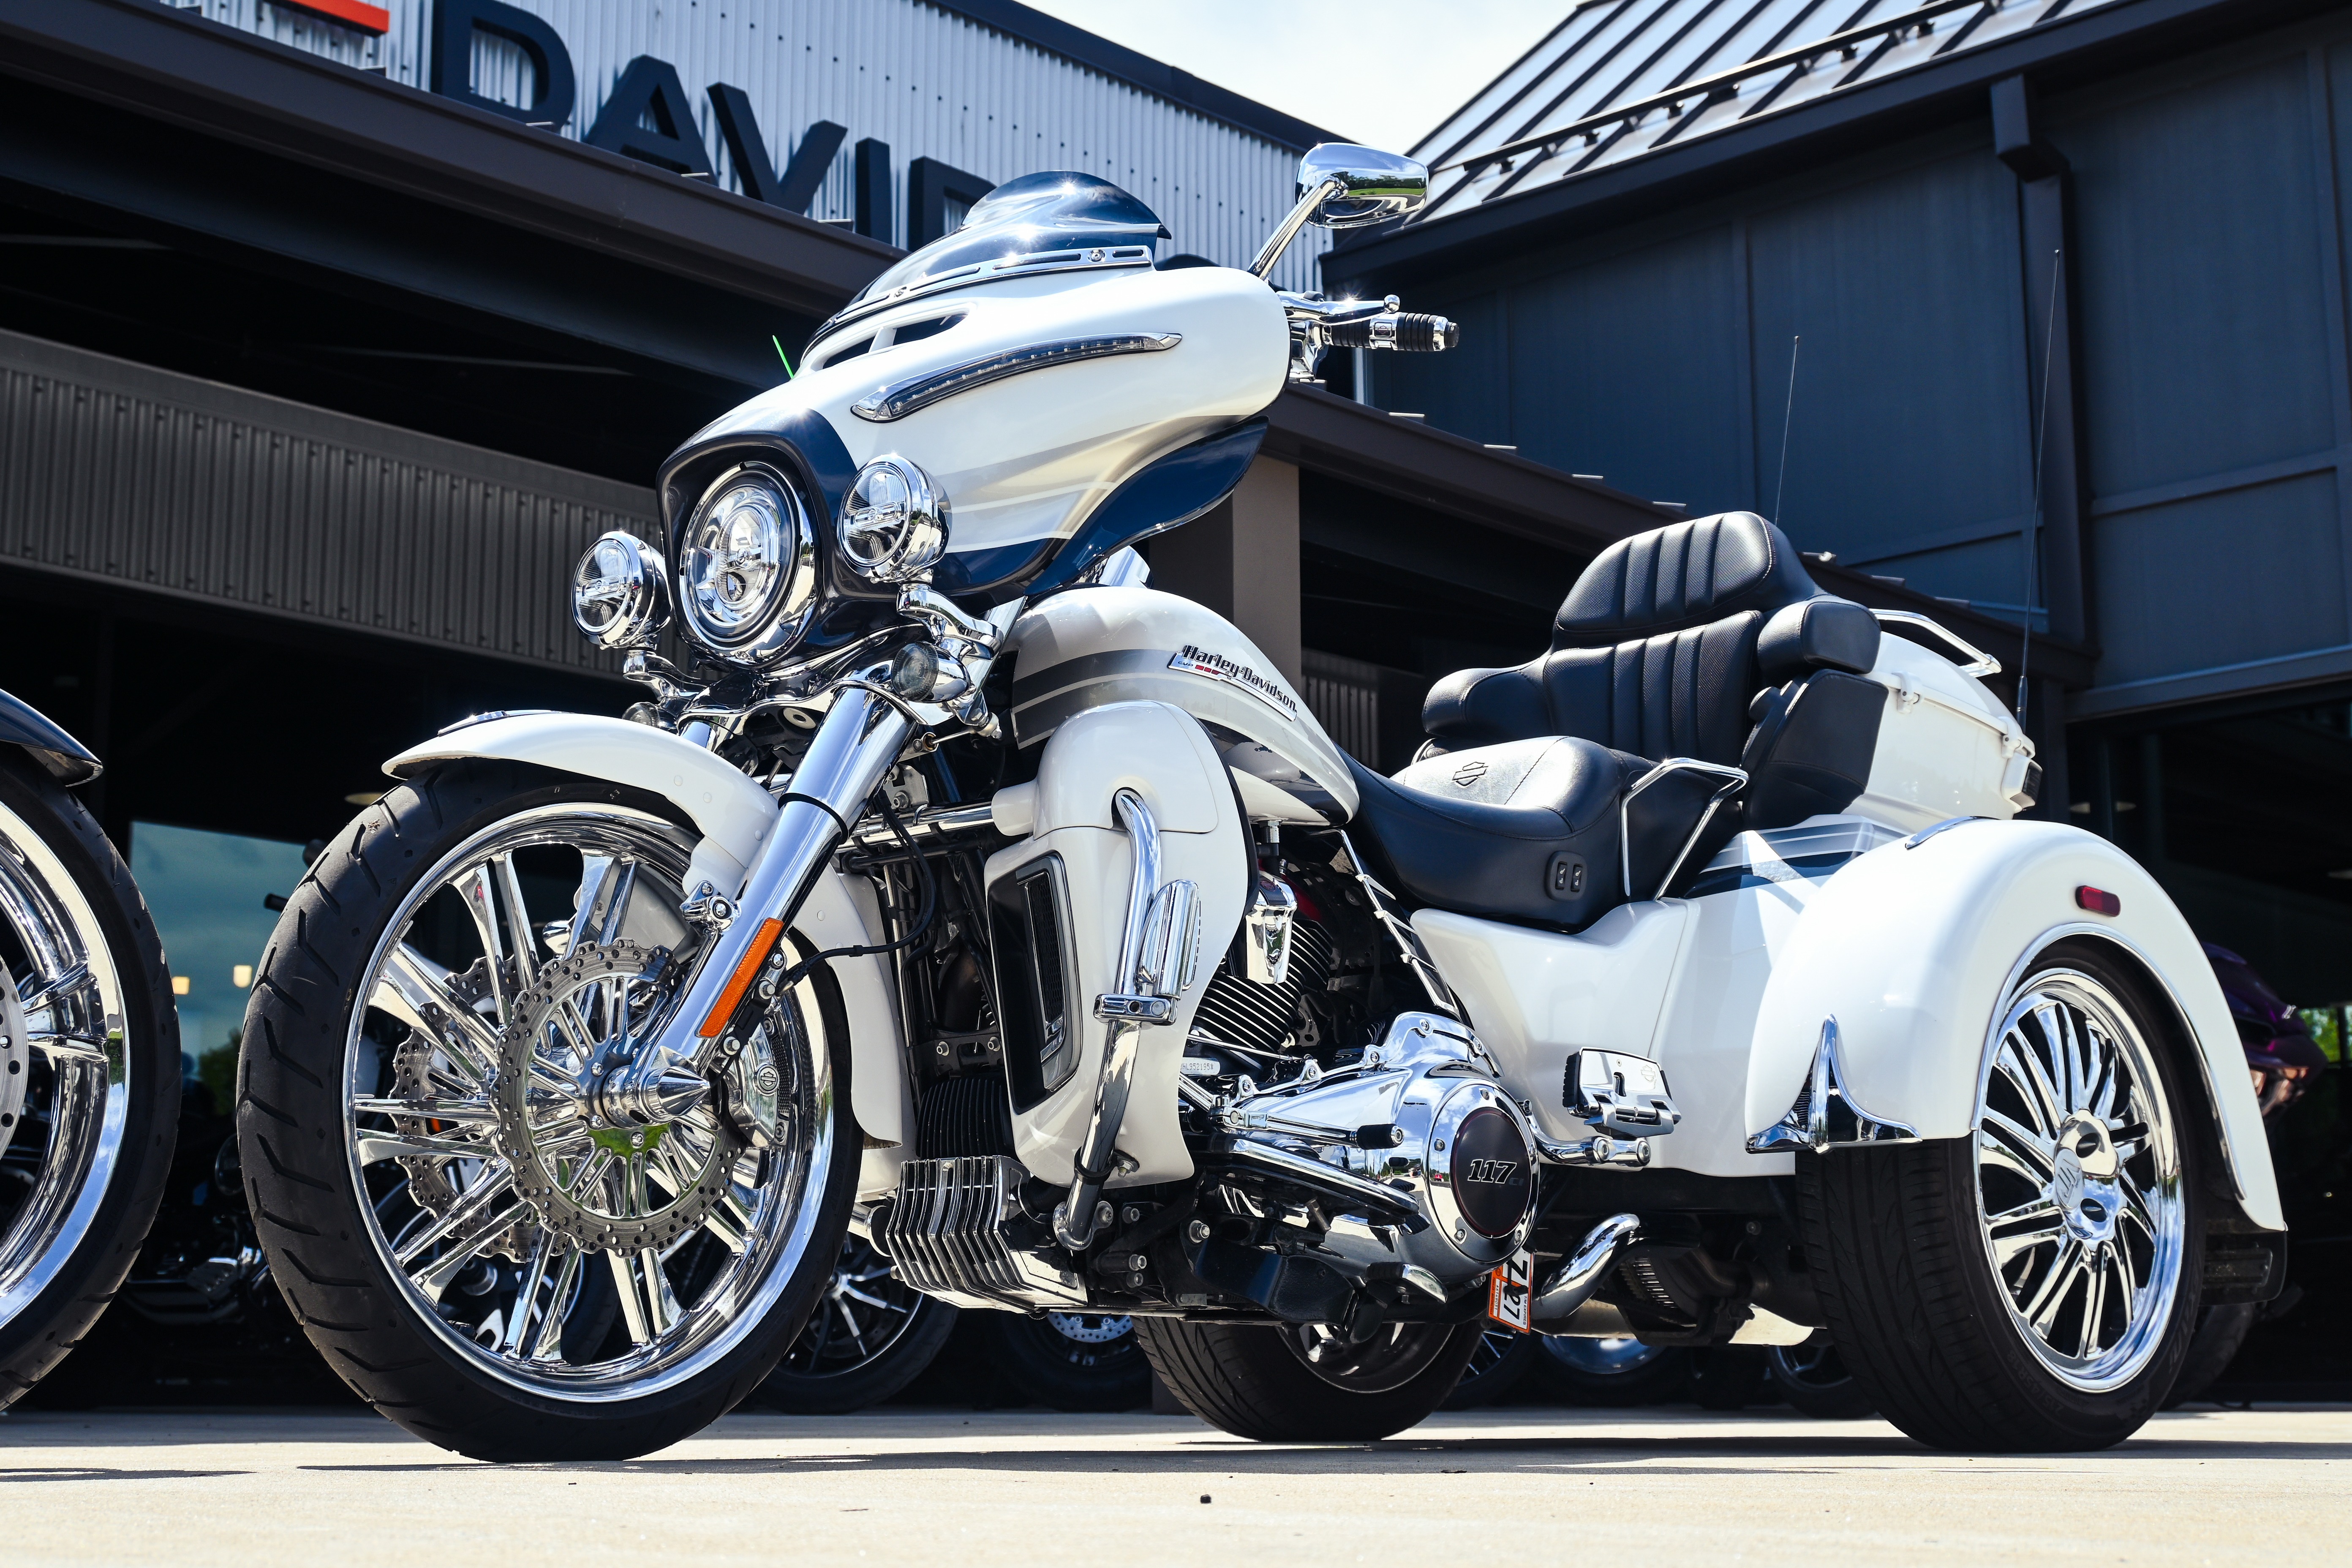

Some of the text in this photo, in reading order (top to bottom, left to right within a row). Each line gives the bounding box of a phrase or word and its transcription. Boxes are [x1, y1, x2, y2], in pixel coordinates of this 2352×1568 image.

[1182, 644, 1296, 711] Harley-Davidson
[1467, 1159, 1524, 1186] 117 CI
[2007, 1350, 2064, 1417] 215/45R18
